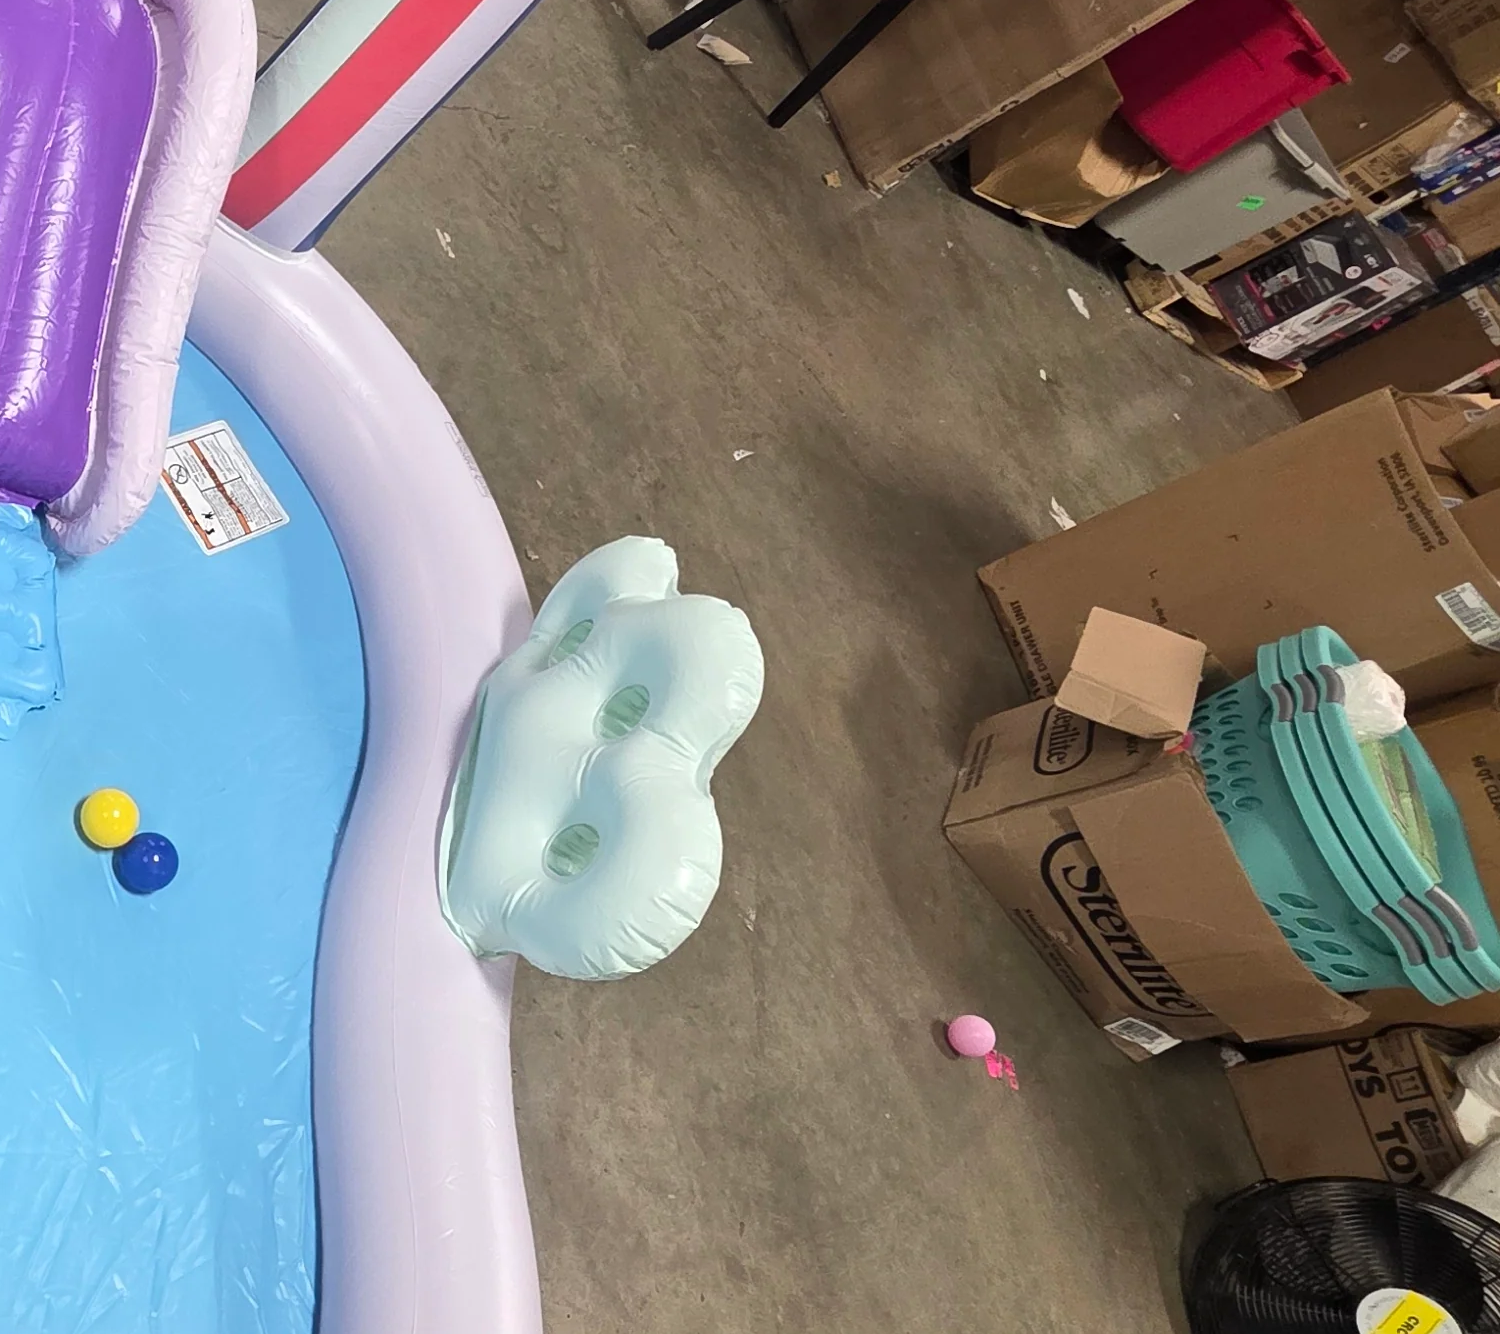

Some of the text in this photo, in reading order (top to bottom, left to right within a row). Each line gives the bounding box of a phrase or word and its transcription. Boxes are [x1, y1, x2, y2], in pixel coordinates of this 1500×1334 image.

[1376, 456, 1437, 553] Sterilite Corporation
[1009, 599, 1028, 626] UNIT
[1019, 625, 1049, 673] DRAWER
[1061, 865, 1197, 1010] Sterilite
